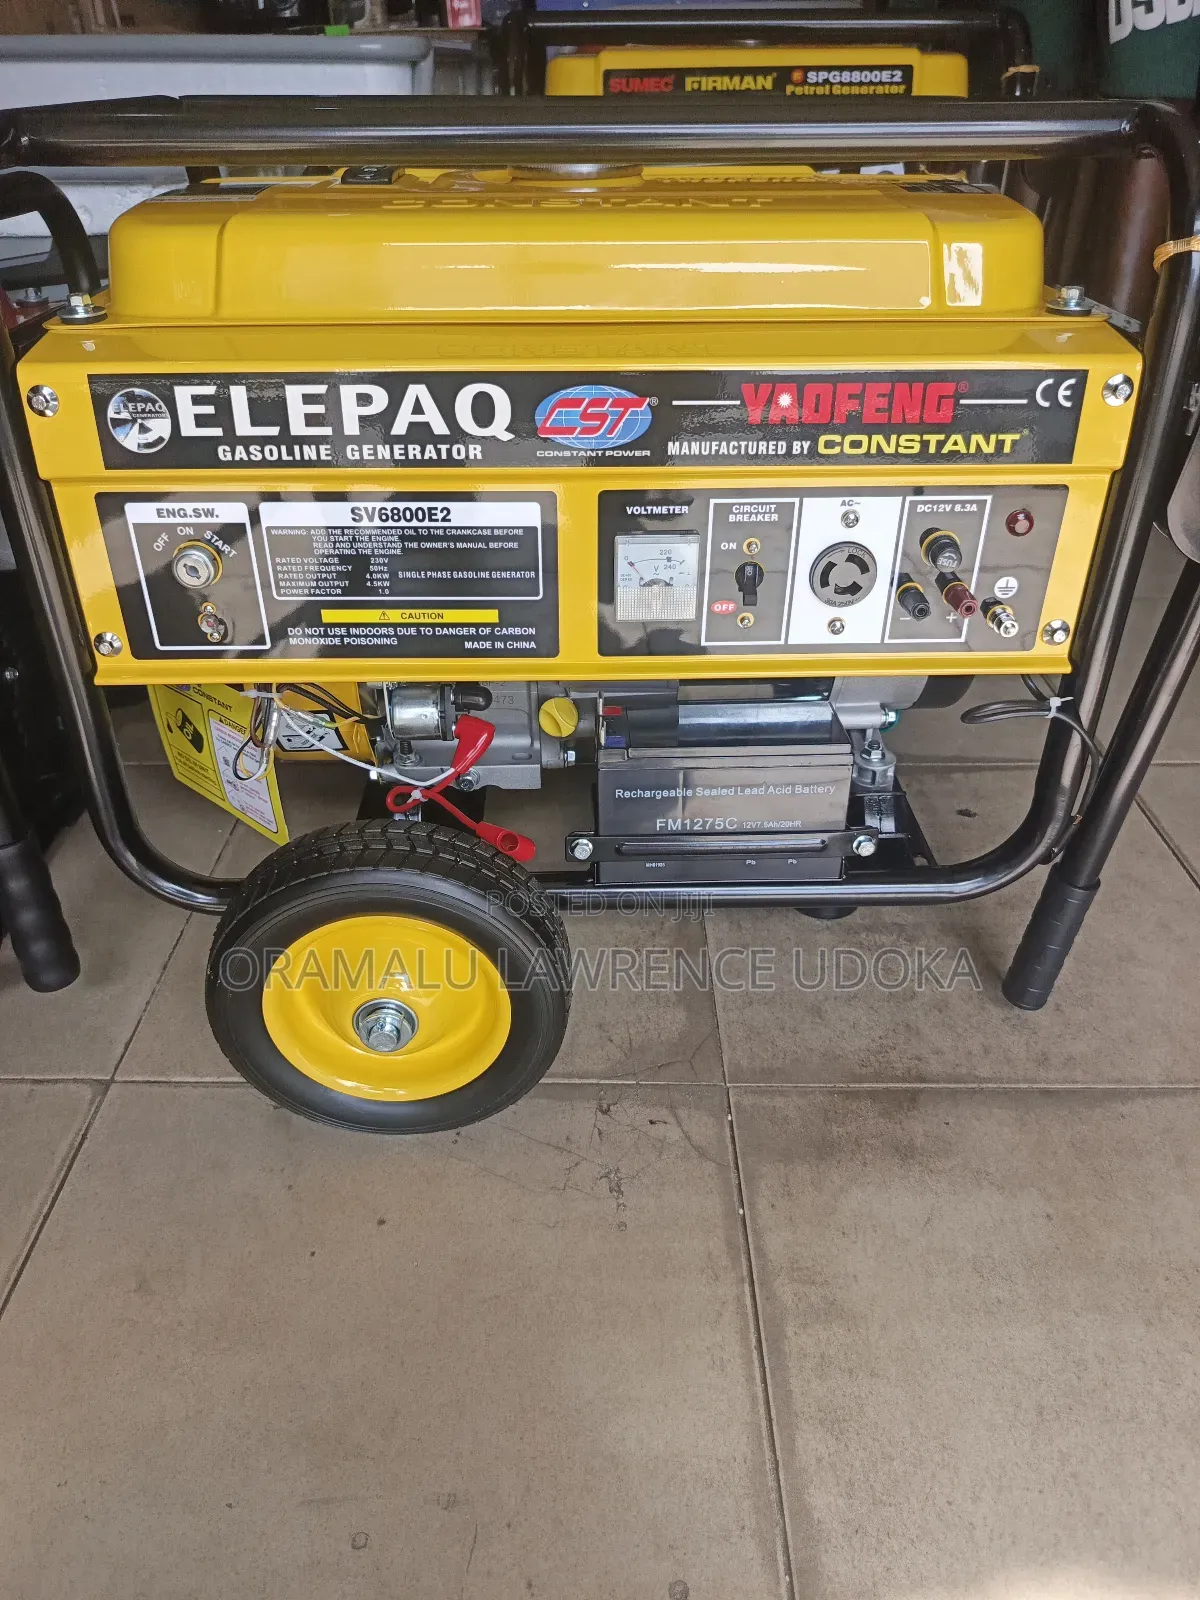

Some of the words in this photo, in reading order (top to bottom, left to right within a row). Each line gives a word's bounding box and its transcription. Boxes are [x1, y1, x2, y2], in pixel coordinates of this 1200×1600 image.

[806, 70, 902, 84] SPG8800E2
[609, 76, 673, 92] SUMEC
[685, 76, 773, 91] FIRMAN
[786, 84, 830, 96] Petrol
[832, 84, 906, 95] Generator
[1035, 378, 1077, 408] CE
[174, 382, 516, 442] ELEPAQ
[217, 444, 332, 461] GASOLINE
[346, 444, 483, 461] GENERATOR
[667, 441, 787, 456] MANUFACTURED
[792, 440, 811, 454] BY
[156, 508, 220, 518] ENG.SW.
[626, 506, 689, 515] VOLTMETER
[732, 504, 776, 513] CIRCUIT
[917, 504, 952, 512] DC12V
[954, 504, 977, 512] 8.3A
[350, 506, 452, 522] SV6800E2
[729, 514, 778, 522] BREAKER
[176, 526, 194, 536] ON
[270, 528, 308, 536] WARNING:
[310, 528, 326, 536] ADD
[328, 528, 342, 536] THE
[344, 528, 402, 536] RECOMMENDED
[404, 528, 416, 536] OIL
[418, 528, 428, 536] TO
[430, 528, 444, 536] THE
[446, 528, 492, 536] CRANKCASE
[494, 528, 524, 536] BEFORE
[153, 532, 170, 552] OFF
[203, 530, 238, 558] START
[721, 542, 736, 550] ON
[847, 547, 866, 559] LOCK
[937, 557, 958, 568] FUSE
[398, 571, 426, 579] SINGLE
[427, 571, 452, 579] PHASE
[453, 571, 490, 579] GASOLINE
[491, 571, 536, 579] GENERATOR
[714, 603, 734, 611] OFF
[401, 612, 444, 620] CAUTION
[287, 627, 302, 635] DO
[305, 627, 325, 635] NOT
[328, 627, 347, 635] USE
[350, 627, 394, 635] INDOORS
[397, 627, 417, 635] DUE
[419, 627, 432, 635] TO
[435, 627, 476, 635] DANGER
[479, 627, 491, 635] OF
[494, 627, 536, 635] CARBON
[464, 641, 492, 649] MADE
[495, 641, 504, 649] IN
[506, 641, 536, 649] CHINA
[184, 722, 194, 740] OIL
[615, 788, 692, 799] Rechargeable
[696, 787, 735, 797] Sealed
[738, 786, 765, 796] Lead
[767, 785, 792, 795] Acid
[795, 784, 835, 795] Battery
[656, 818, 738, 831] FM1275C
